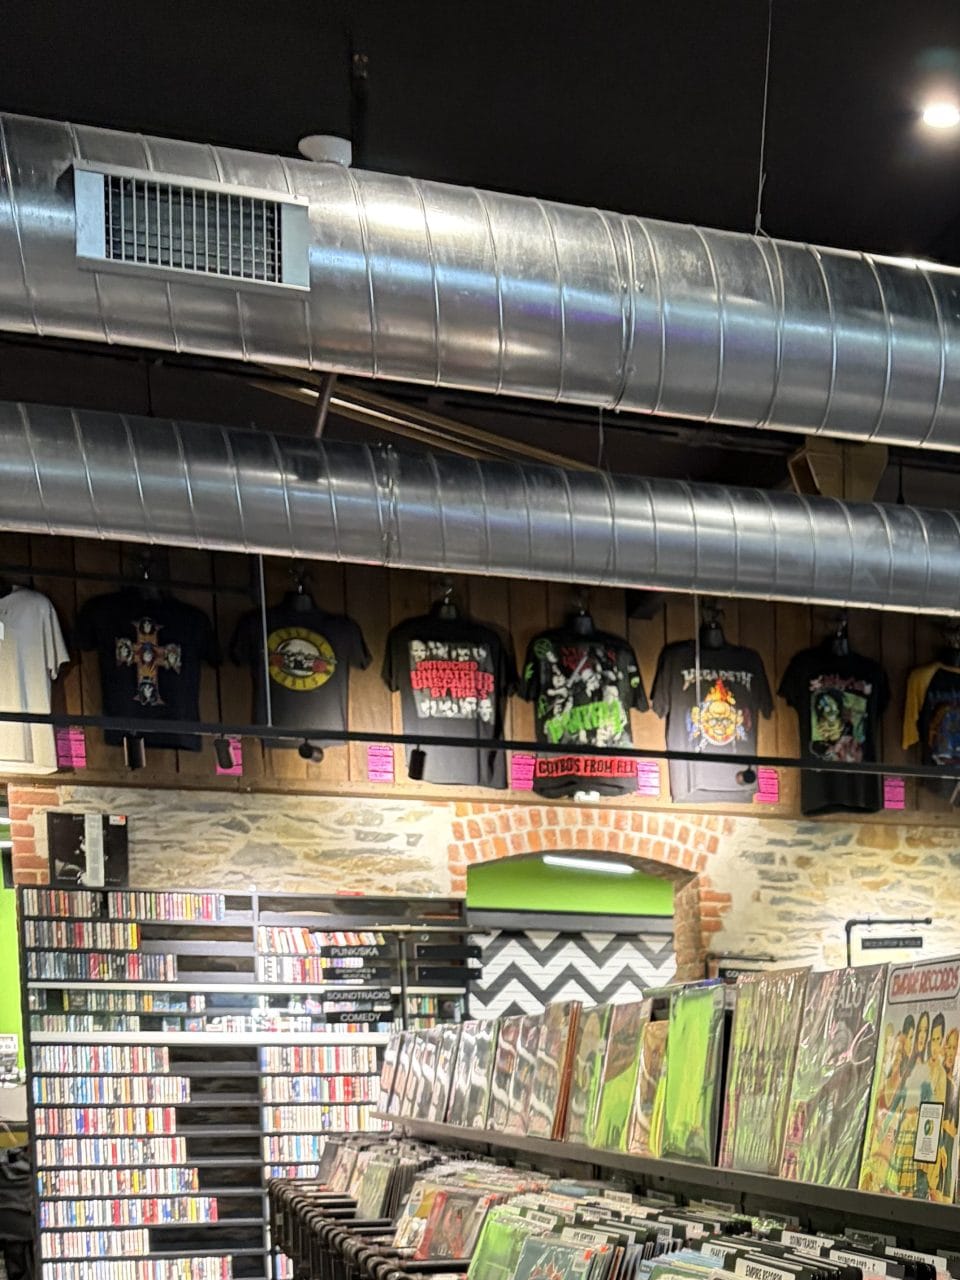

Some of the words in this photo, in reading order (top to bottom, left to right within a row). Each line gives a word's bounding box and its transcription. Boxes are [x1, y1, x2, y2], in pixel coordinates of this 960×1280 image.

[681, 669, 753, 691] MEGADETH
[331, 947, 379, 957] PUNK/SKA
[327, 991, 390, 1000] SOUNDTRACKS
[341, 1013, 381, 1022] COMEDY
[745, 1264, 763, 1280] EMPIRE
